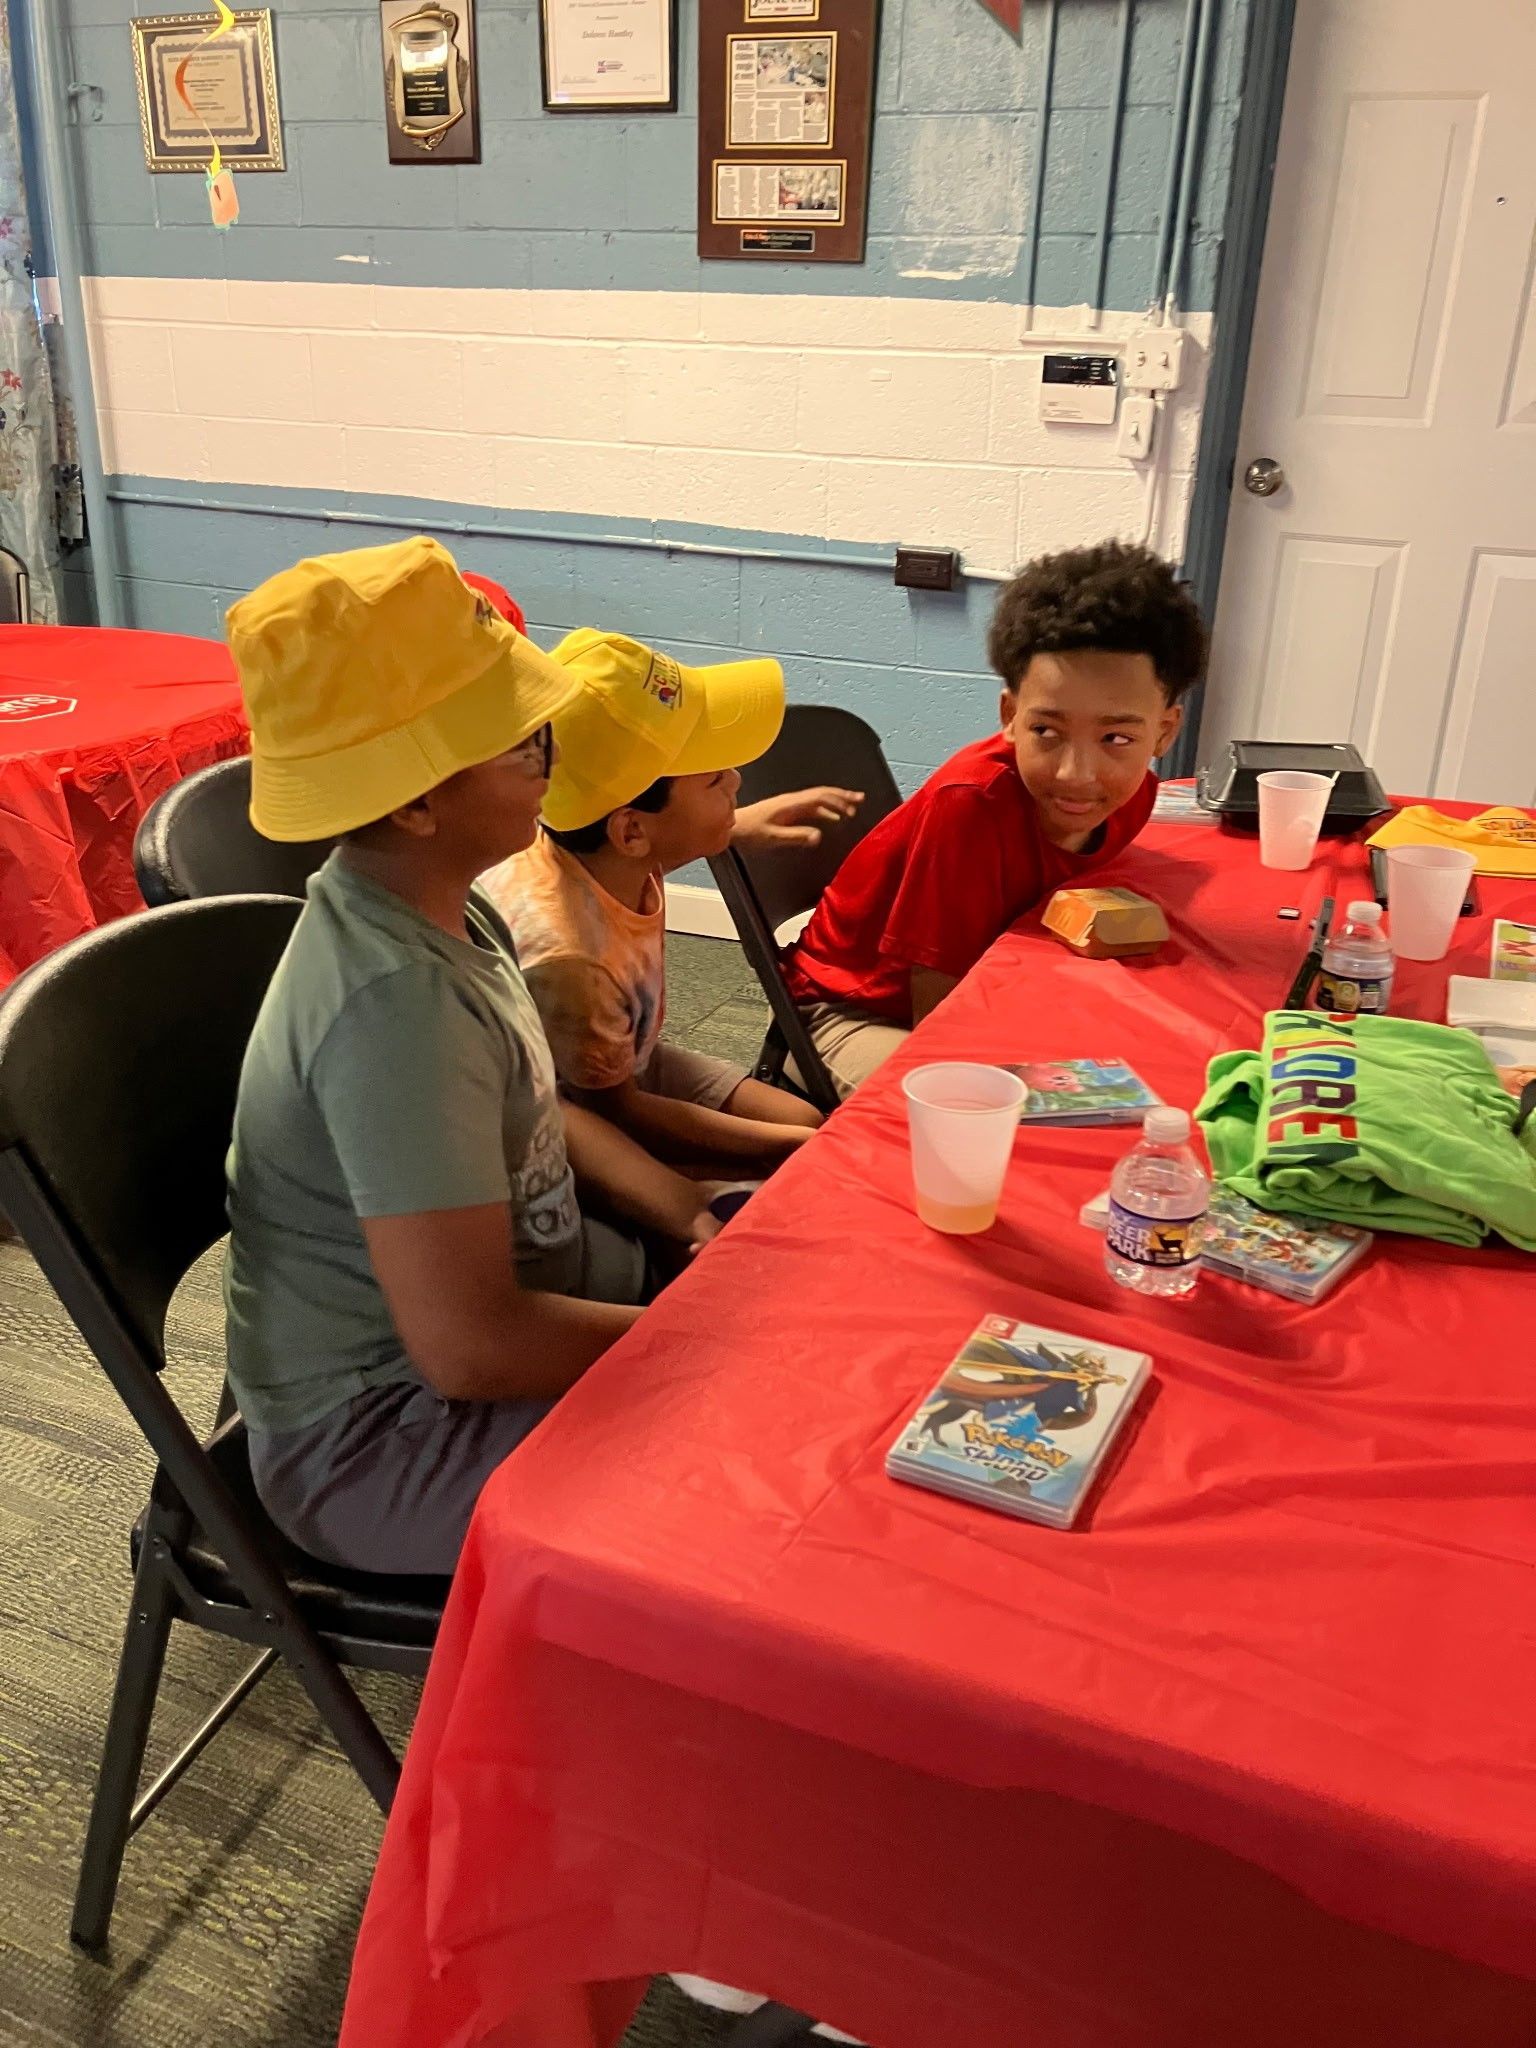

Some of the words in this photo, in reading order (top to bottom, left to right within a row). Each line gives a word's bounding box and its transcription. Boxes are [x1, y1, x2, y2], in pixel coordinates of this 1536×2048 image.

[1268, 1012, 1360, 1168] HILDREN
[1107, 1226, 1151, 1262] PARK
[1109, 1211, 1151, 1244] DEER
